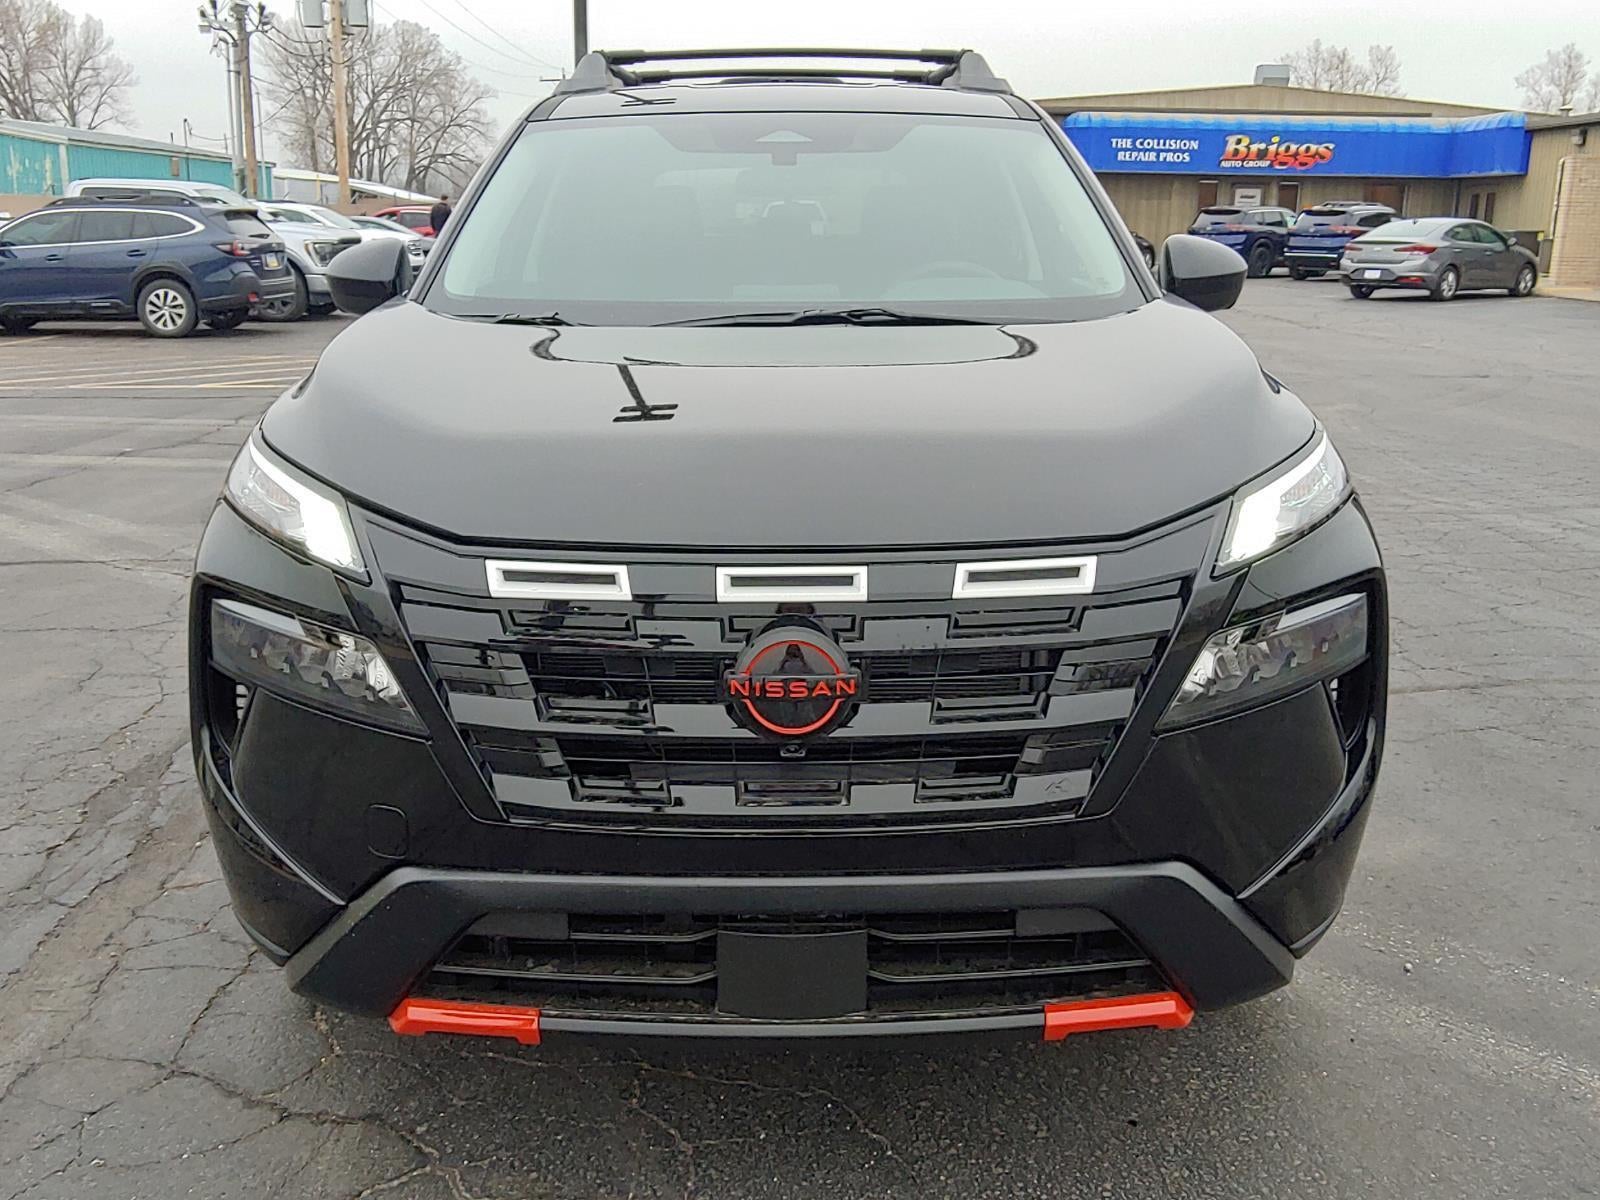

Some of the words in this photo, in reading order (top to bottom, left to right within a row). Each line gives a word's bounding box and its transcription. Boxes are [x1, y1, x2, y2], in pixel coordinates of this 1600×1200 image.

[1111, 138, 1133, 149] THE
[1135, 138, 1199, 150] COLLISION
[1117, 151, 1157, 162] REPAIR
[1159, 152, 1191, 163] PROS
[1220, 135, 1336, 169] Briggs
[1220, 160, 1242, 168] AUTO
[1243, 160, 1271, 168] GROUP
[729, 679, 857, 698] NISSAN
